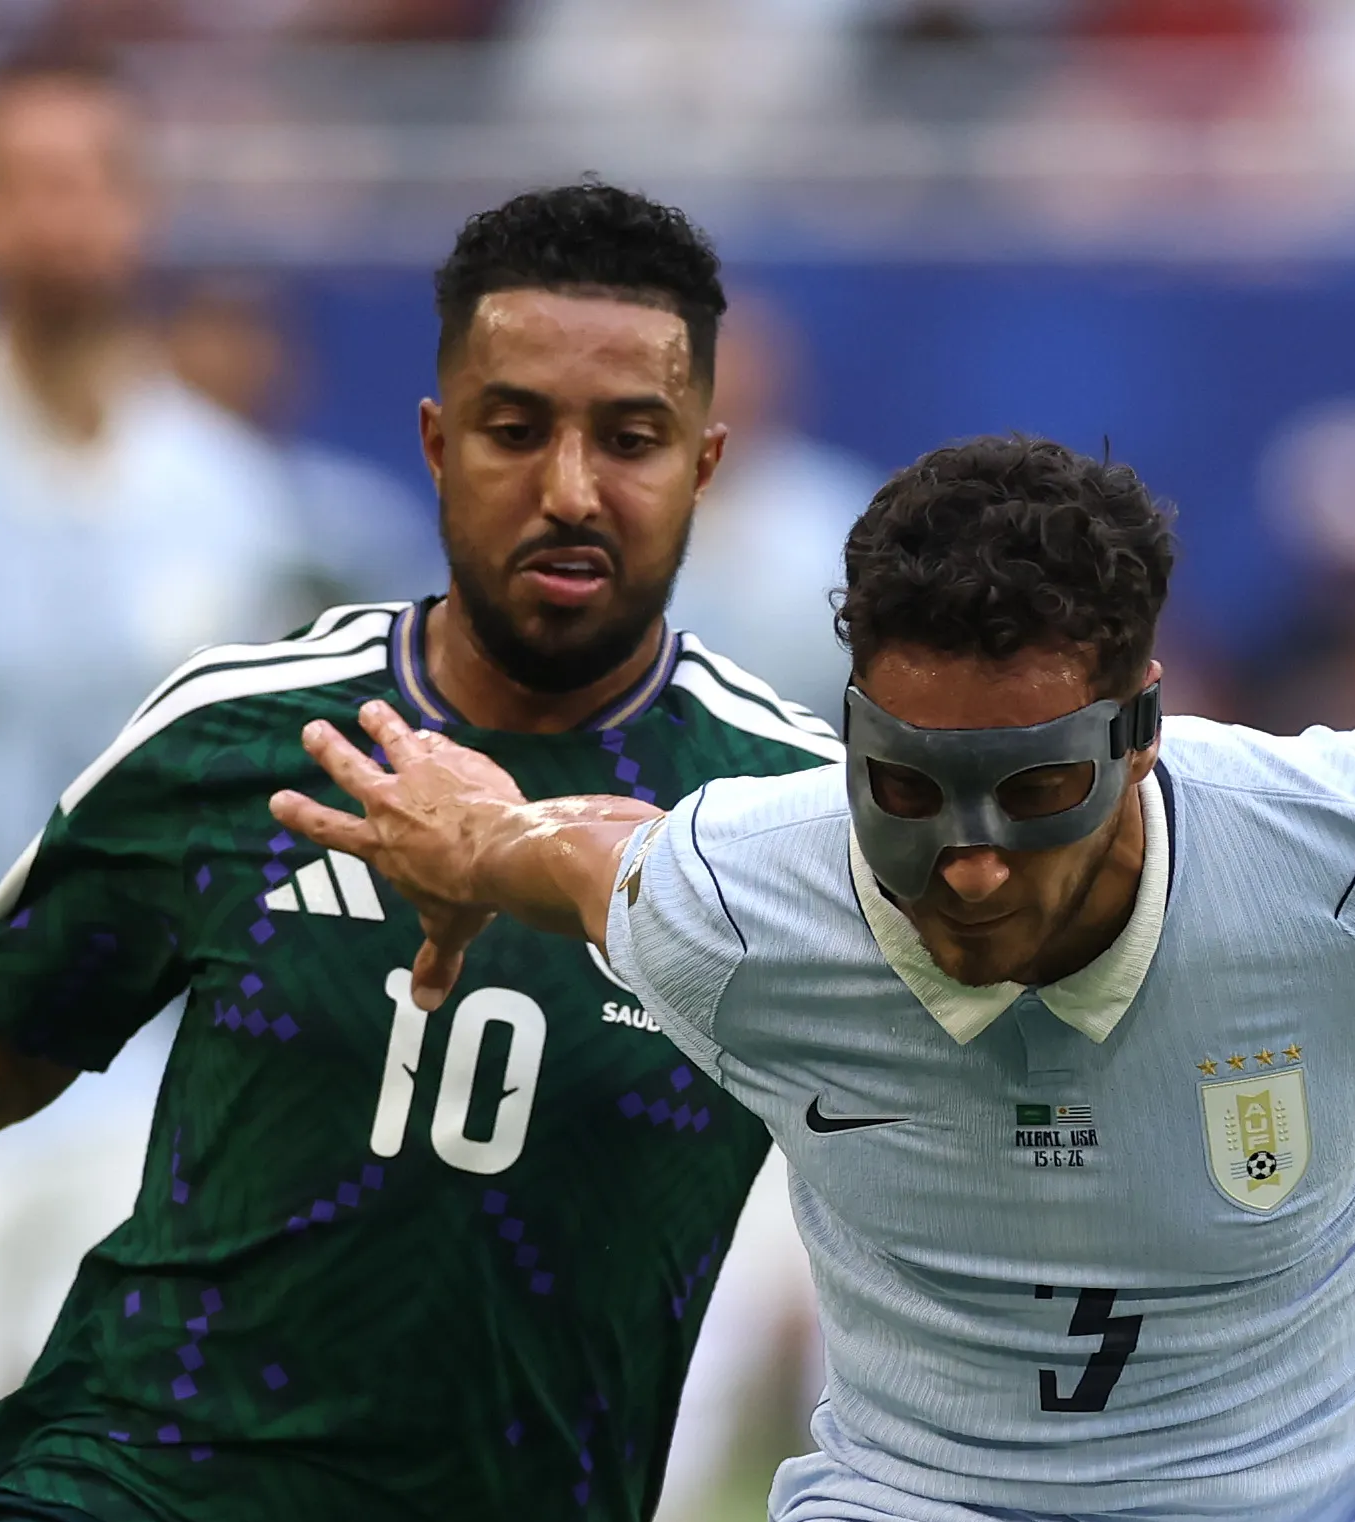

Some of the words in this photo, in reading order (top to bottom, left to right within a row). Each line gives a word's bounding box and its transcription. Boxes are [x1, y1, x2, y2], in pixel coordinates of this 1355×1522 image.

[370, 967, 546, 1174] 10
[1015, 1130, 1066, 1148] MIAMI,
[1070, 1128, 1099, 1147] USA
[1244, 1103, 1271, 1151] AUF
[1034, 1285, 1144, 1413] 3
